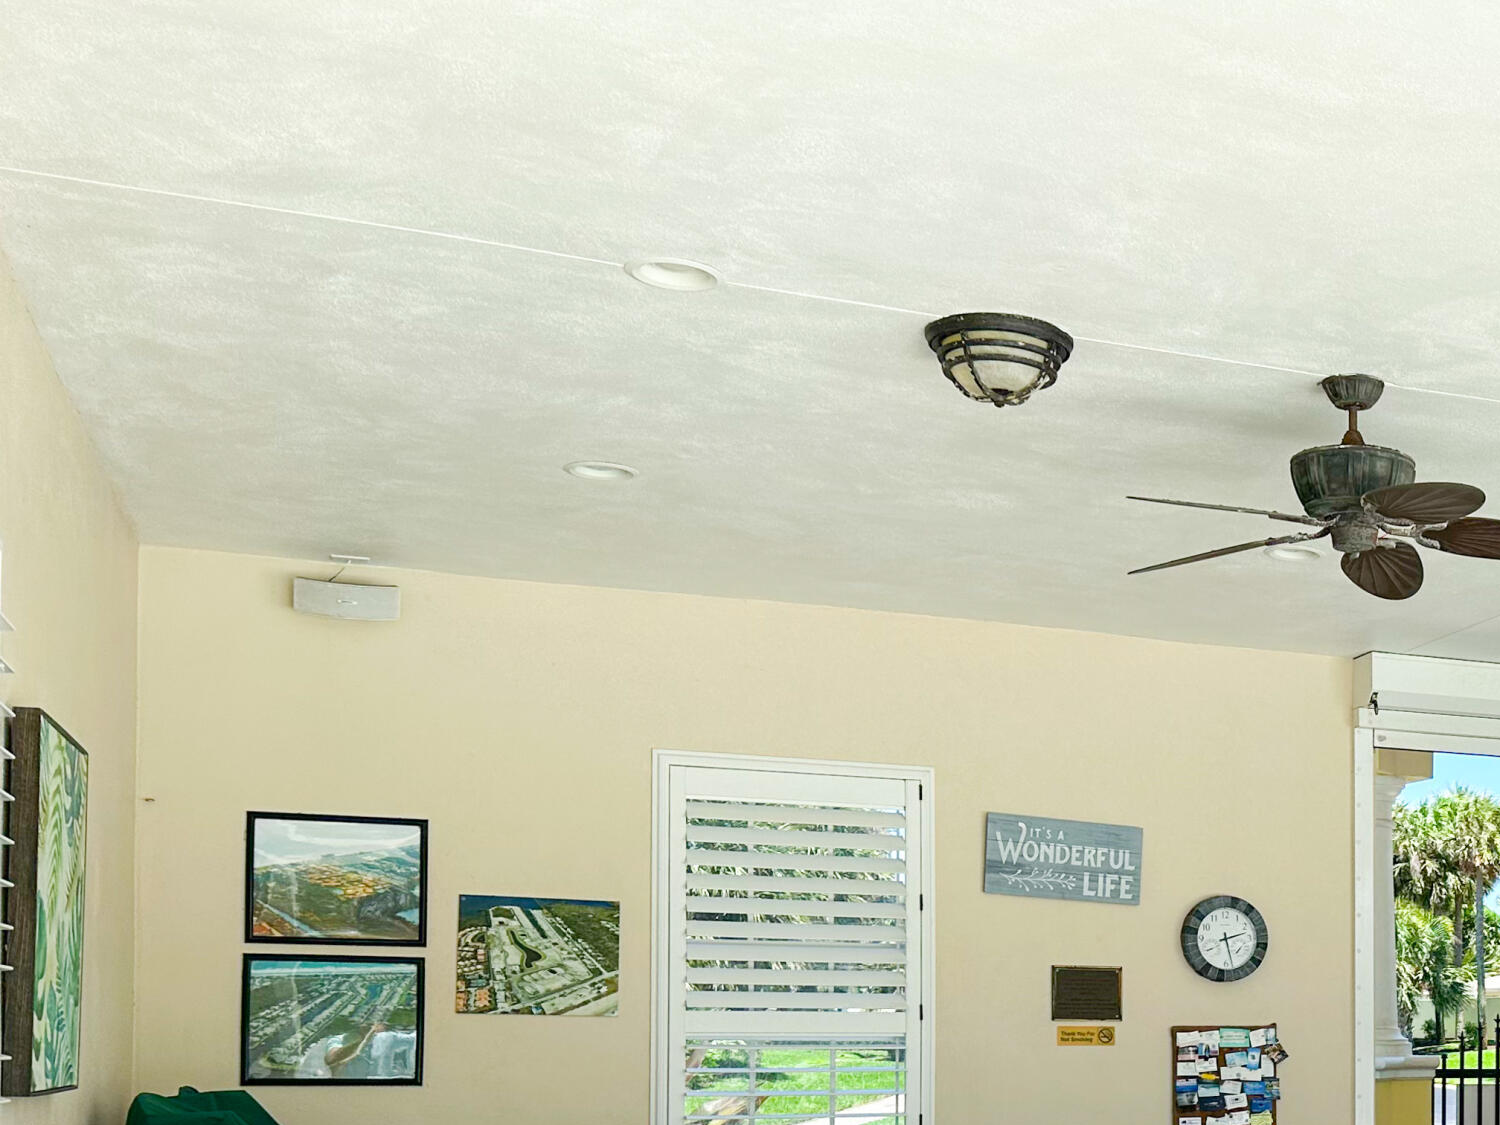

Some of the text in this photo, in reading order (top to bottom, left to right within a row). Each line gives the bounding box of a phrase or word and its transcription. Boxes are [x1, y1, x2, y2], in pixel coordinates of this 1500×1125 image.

[995, 821, 1136, 871] WONDERFUL
[1030, 827, 1065, 841] IT'S A
[1082, 872, 1135, 899] LIFE
